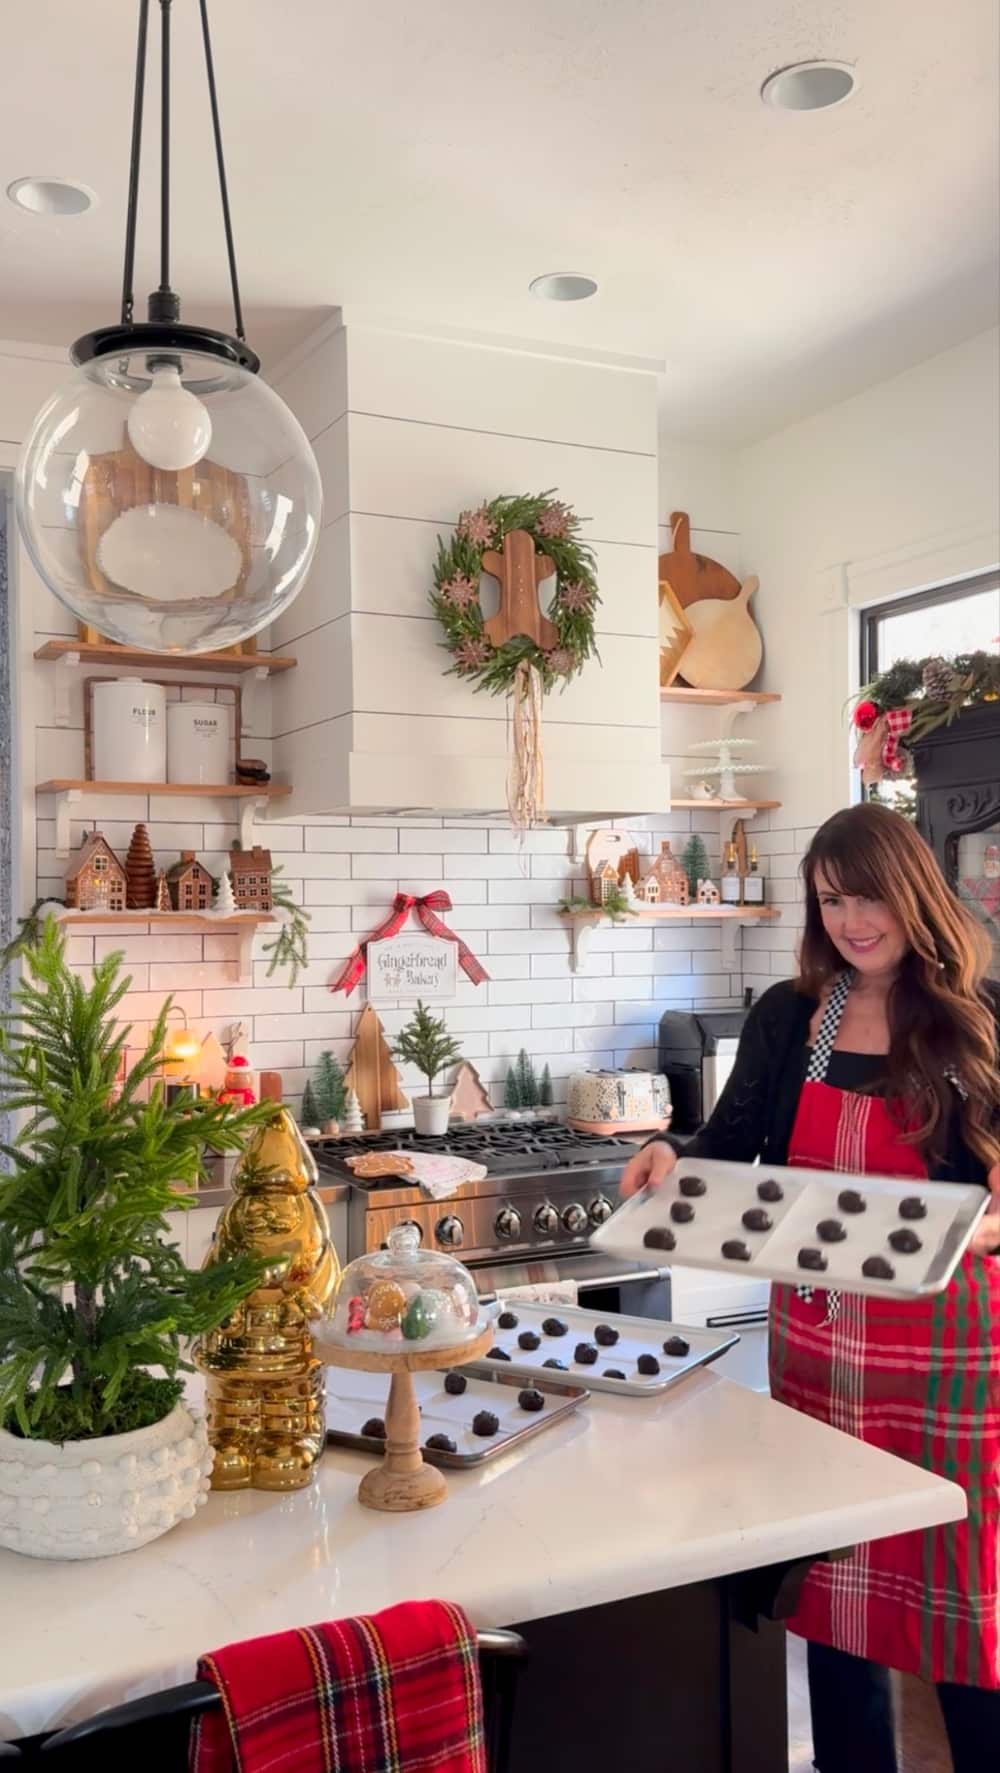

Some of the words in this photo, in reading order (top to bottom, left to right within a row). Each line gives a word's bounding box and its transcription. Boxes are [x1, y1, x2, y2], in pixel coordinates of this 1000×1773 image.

[193, 719, 218, 727] SUGAR
[377, 953, 447, 970] Gingerbread
[407, 970, 440, 987] Bakery
